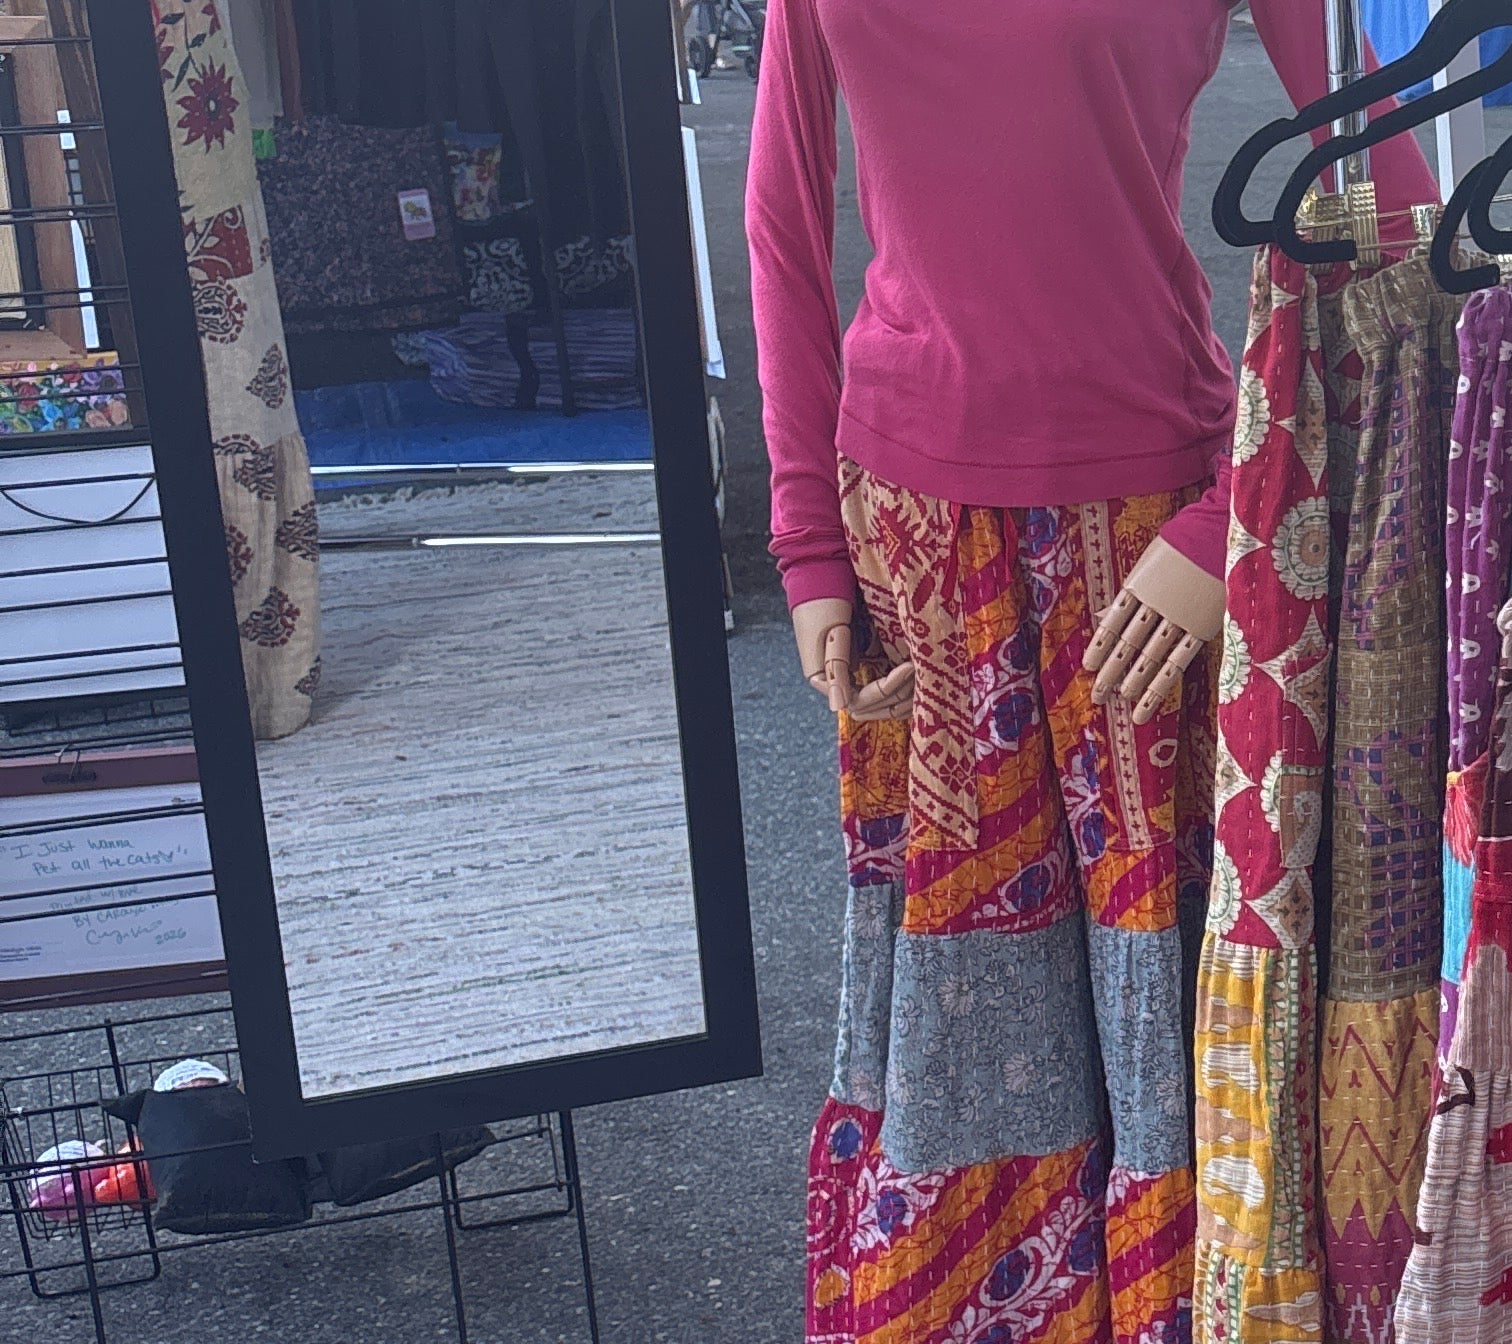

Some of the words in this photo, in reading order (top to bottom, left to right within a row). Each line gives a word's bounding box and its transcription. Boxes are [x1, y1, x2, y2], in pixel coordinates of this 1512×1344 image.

[71, 858, 91, 872] all
[99, 855, 125, 870] the
[154, 928, 187, 945] 2026
